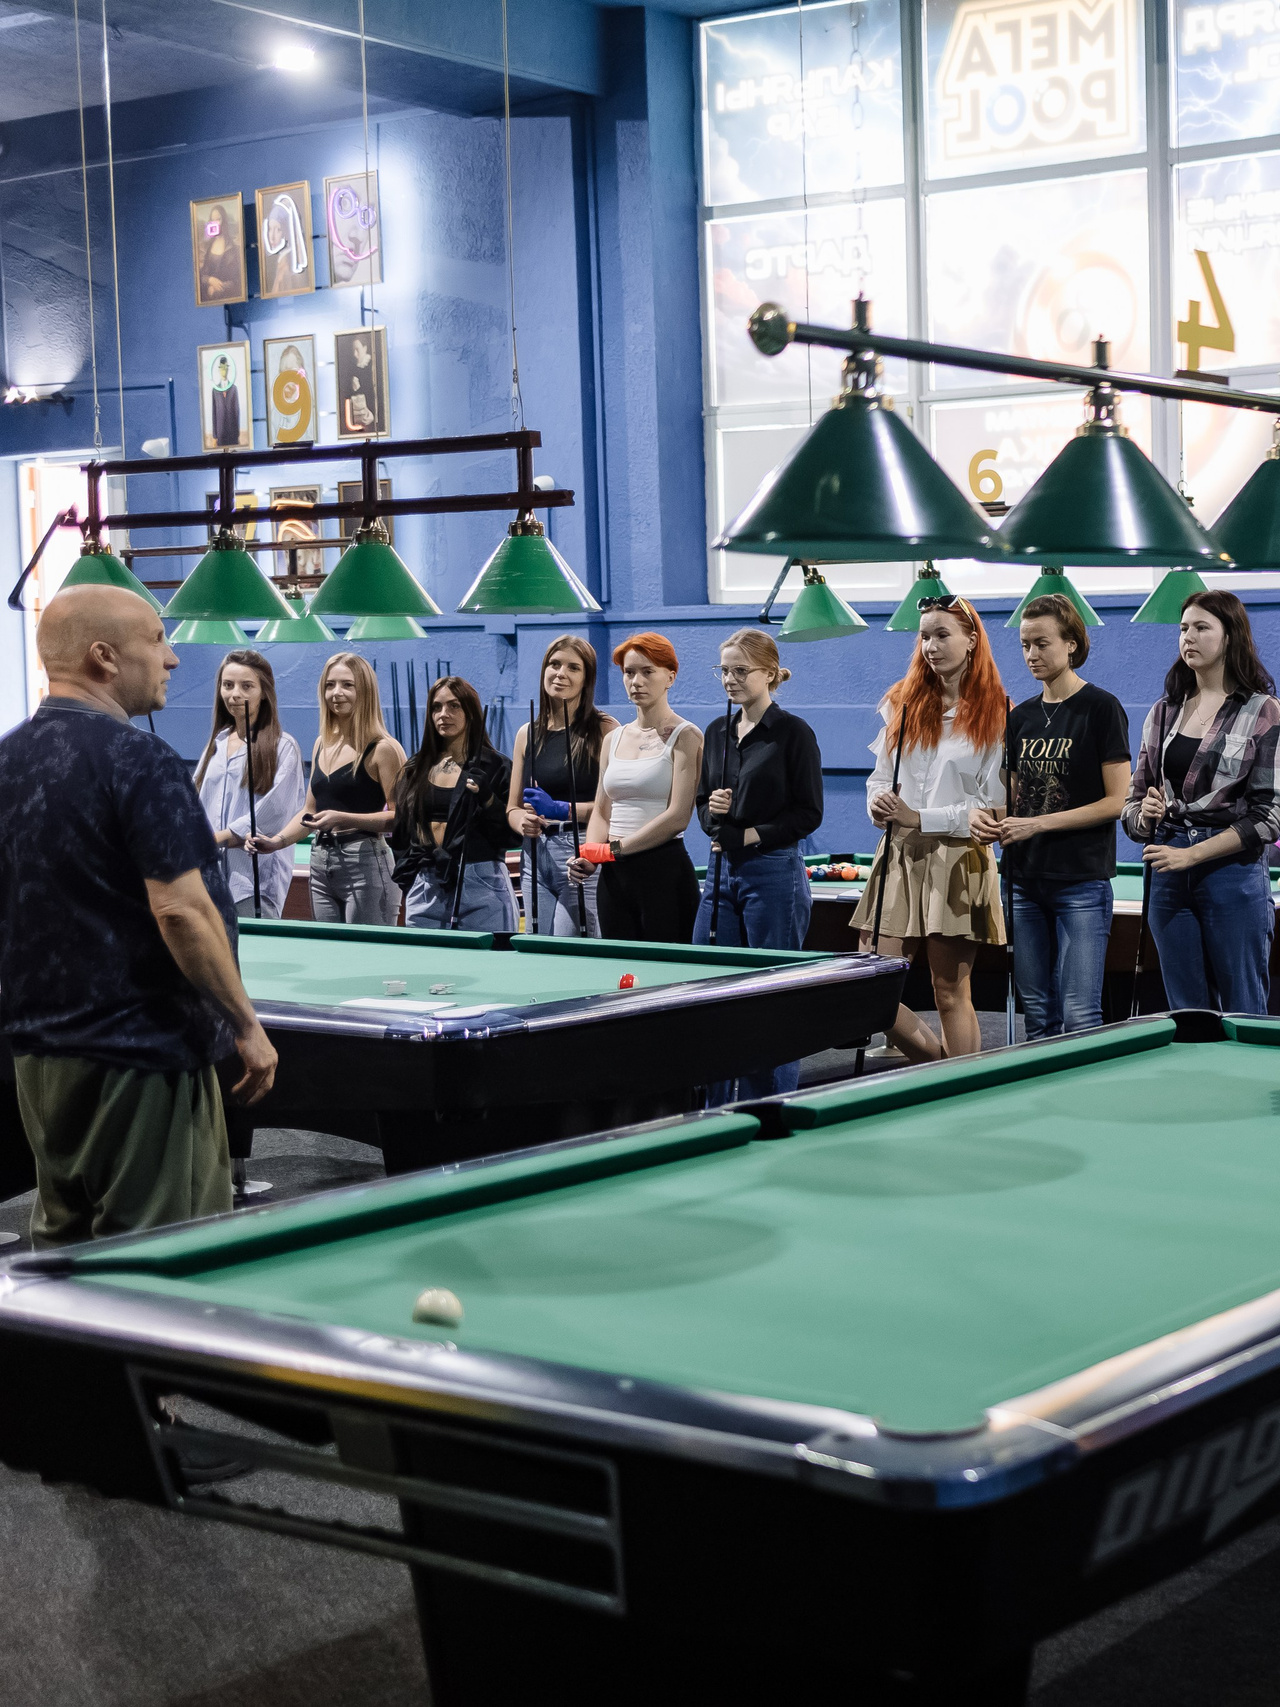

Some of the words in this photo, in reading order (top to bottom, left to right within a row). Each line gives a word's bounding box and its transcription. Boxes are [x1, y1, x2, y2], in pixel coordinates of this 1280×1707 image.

[273, 370, 311, 443] 9
[968, 449, 1003, 502] 6
[1020, 738, 1073, 759] YOUR
